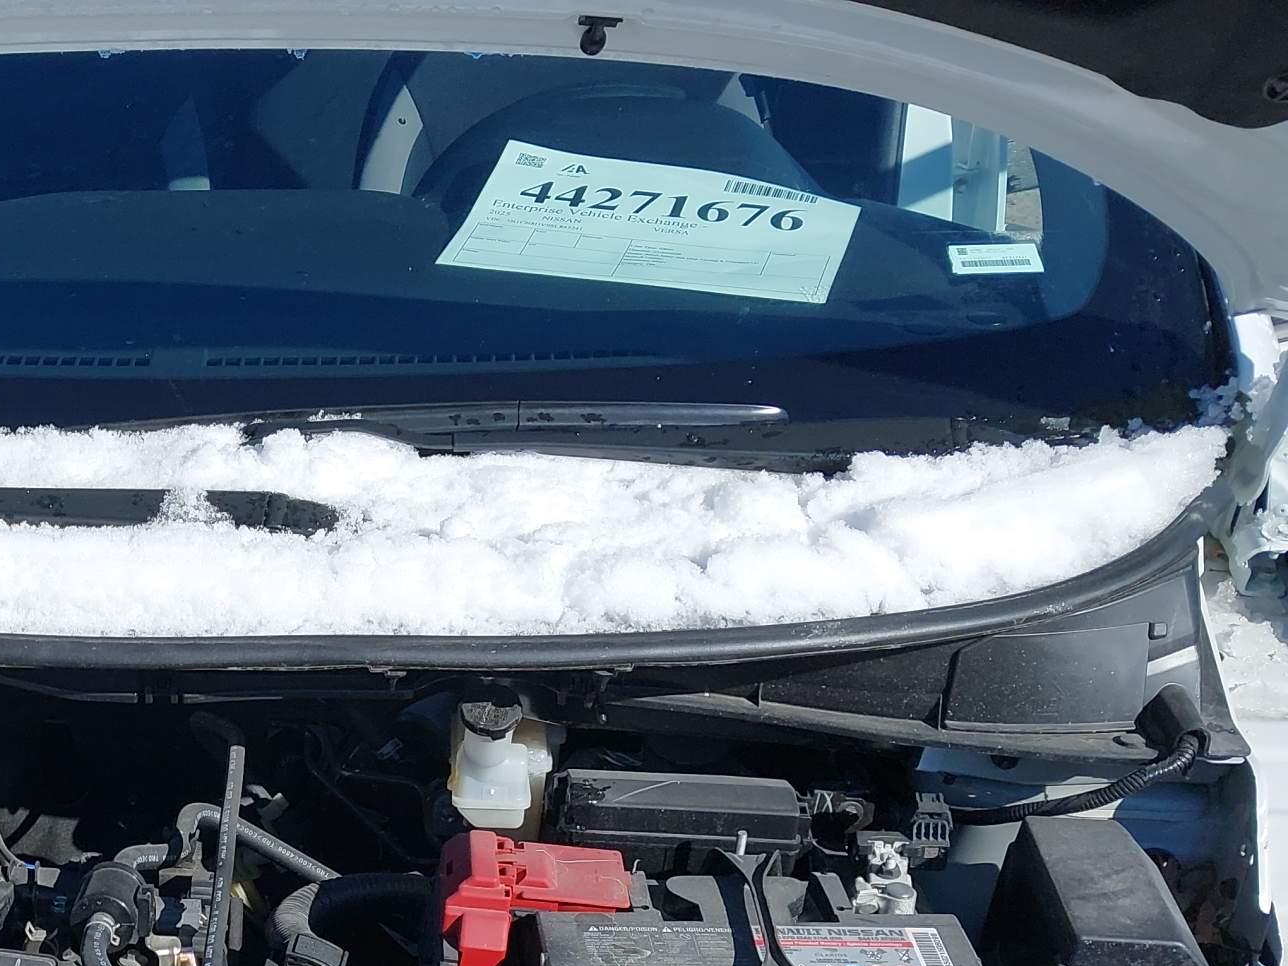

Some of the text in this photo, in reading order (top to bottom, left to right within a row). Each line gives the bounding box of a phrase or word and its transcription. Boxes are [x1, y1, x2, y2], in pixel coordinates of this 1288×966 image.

[492, 199, 563, 216] Enterprise
[569, 206, 622, 221] Vehicle
[627, 214, 698, 229] Exchange
[519, 181, 808, 231] 44271676
[542, 215, 582, 224] NISSAN
[653, 226, 690, 236] VERSA
[827, 928, 904, 937] NISSAN
